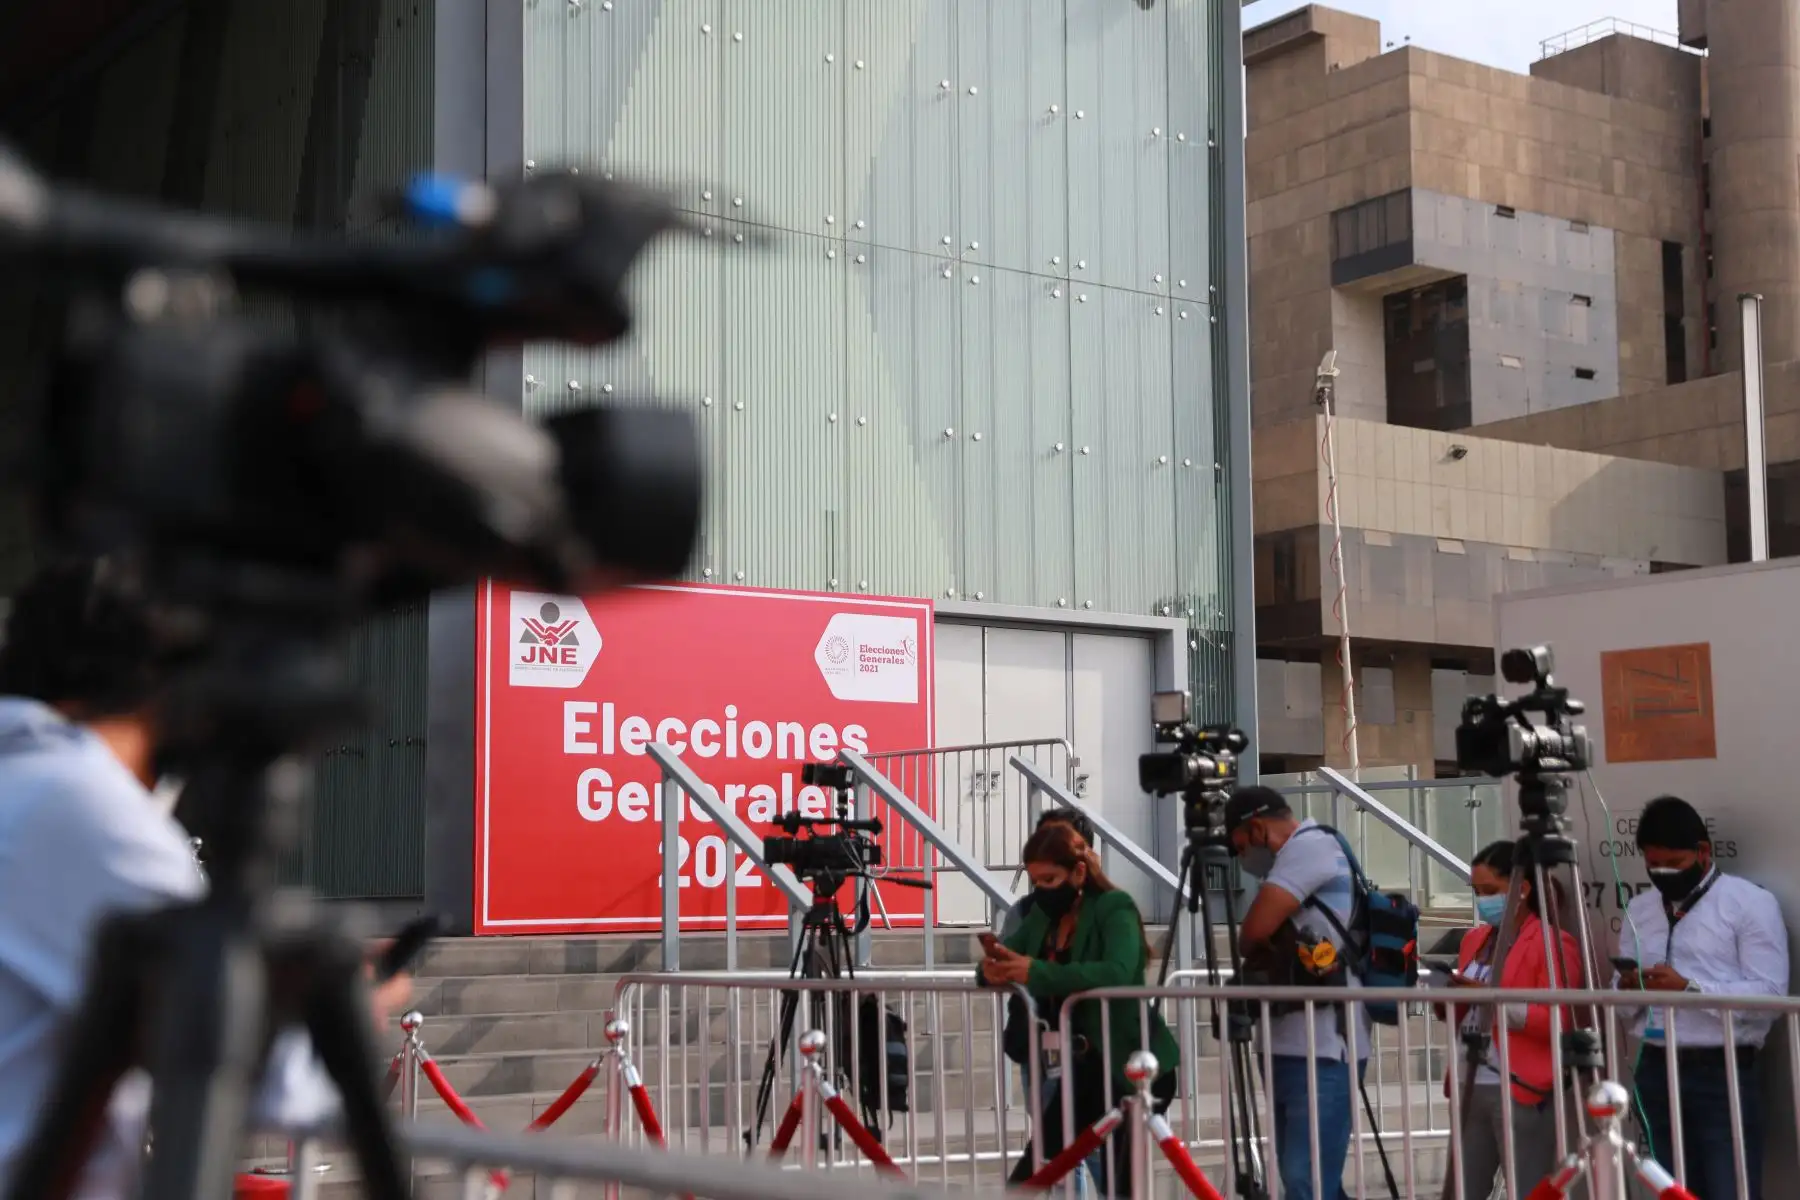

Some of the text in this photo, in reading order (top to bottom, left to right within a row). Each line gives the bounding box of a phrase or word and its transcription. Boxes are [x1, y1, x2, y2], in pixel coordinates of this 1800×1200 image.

[521, 646, 577, 665] JNE
[859, 644, 905, 656] Elecciones
[859, 654, 905, 665] Generales
[859, 664, 879, 673] 2021
[564, 700, 869, 761] Elecciones
[658, 834, 777, 889] 202
